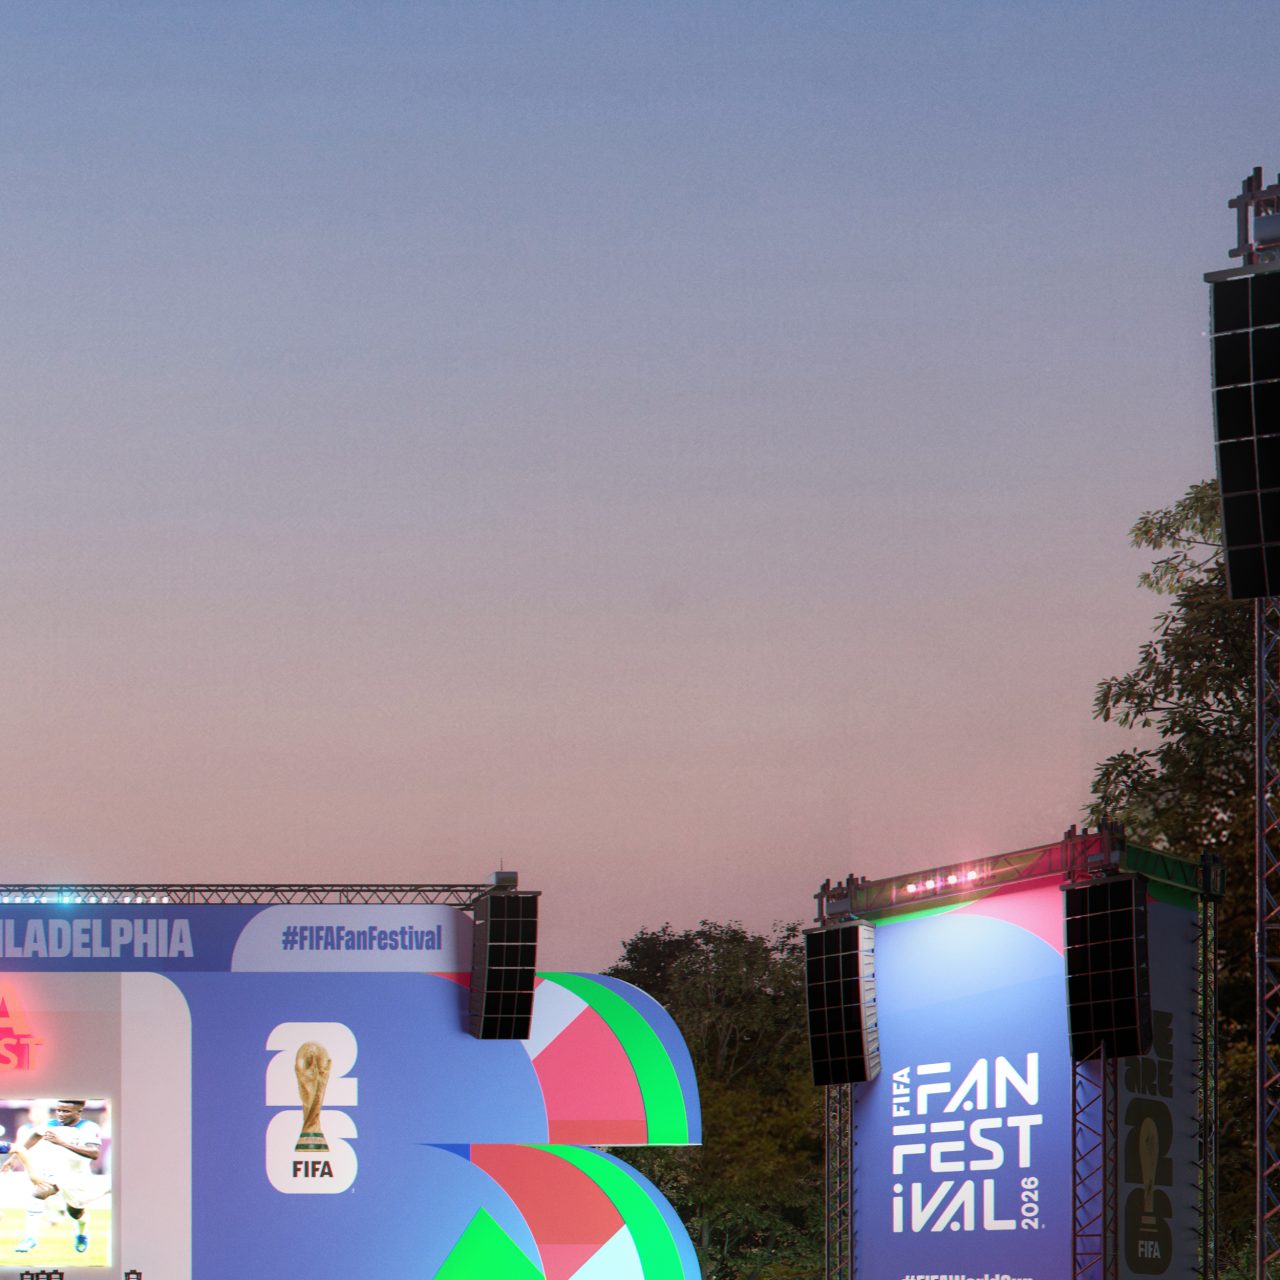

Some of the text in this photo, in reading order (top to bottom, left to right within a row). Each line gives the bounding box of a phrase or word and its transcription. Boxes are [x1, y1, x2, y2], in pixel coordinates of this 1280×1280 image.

[282, 925, 442, 951] #FIFAFanFestival
[892, 1052, 1039, 1117] FIFA FAN
[892, 1114, 1043, 1175] FEST
[292, 1161, 334, 1178] FIFA
[1021, 1176, 1039, 1230] 2026
[1138, 1240, 1161, 1259] FIFA
